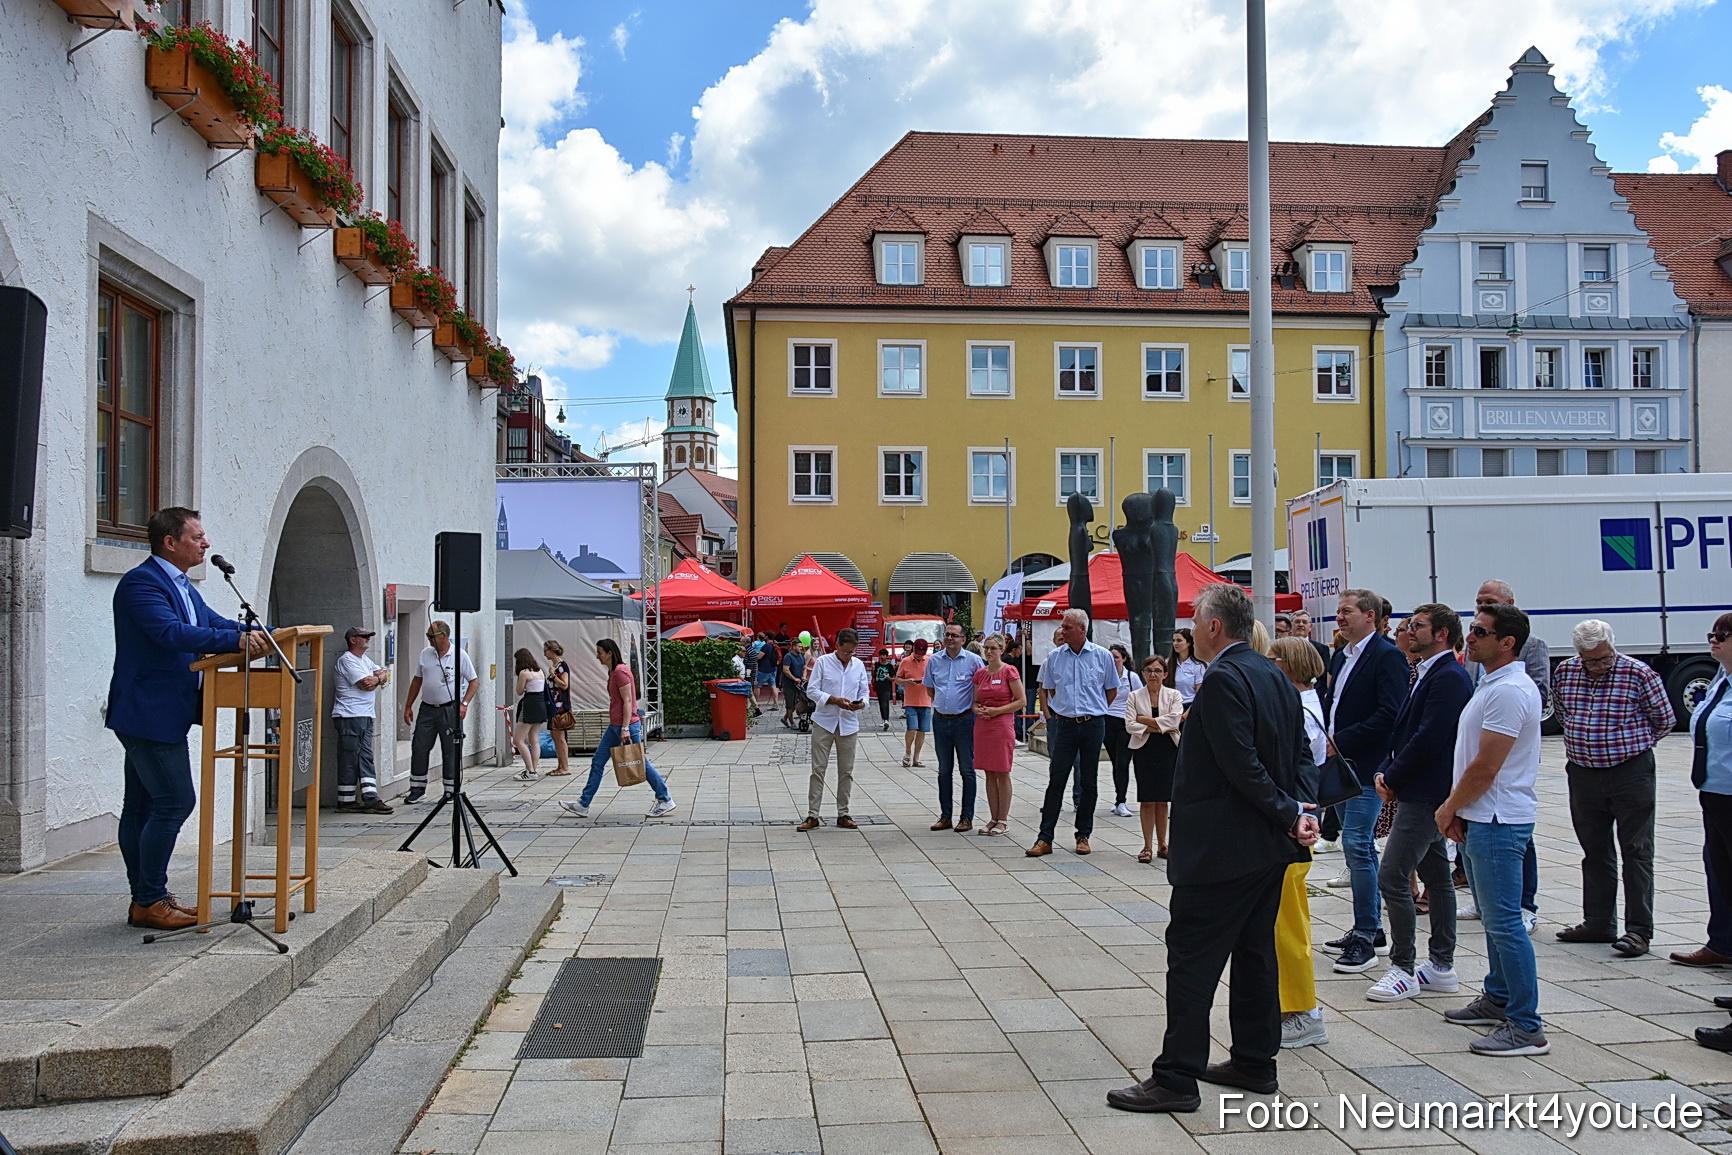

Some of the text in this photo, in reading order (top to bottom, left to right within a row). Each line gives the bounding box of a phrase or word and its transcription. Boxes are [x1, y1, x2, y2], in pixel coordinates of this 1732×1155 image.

[1486, 410, 1608, 426] BRILLEN WEBER
[1664, 516, 1732, 570] PF
[1301, 577, 1340, 599] PFLEERER
